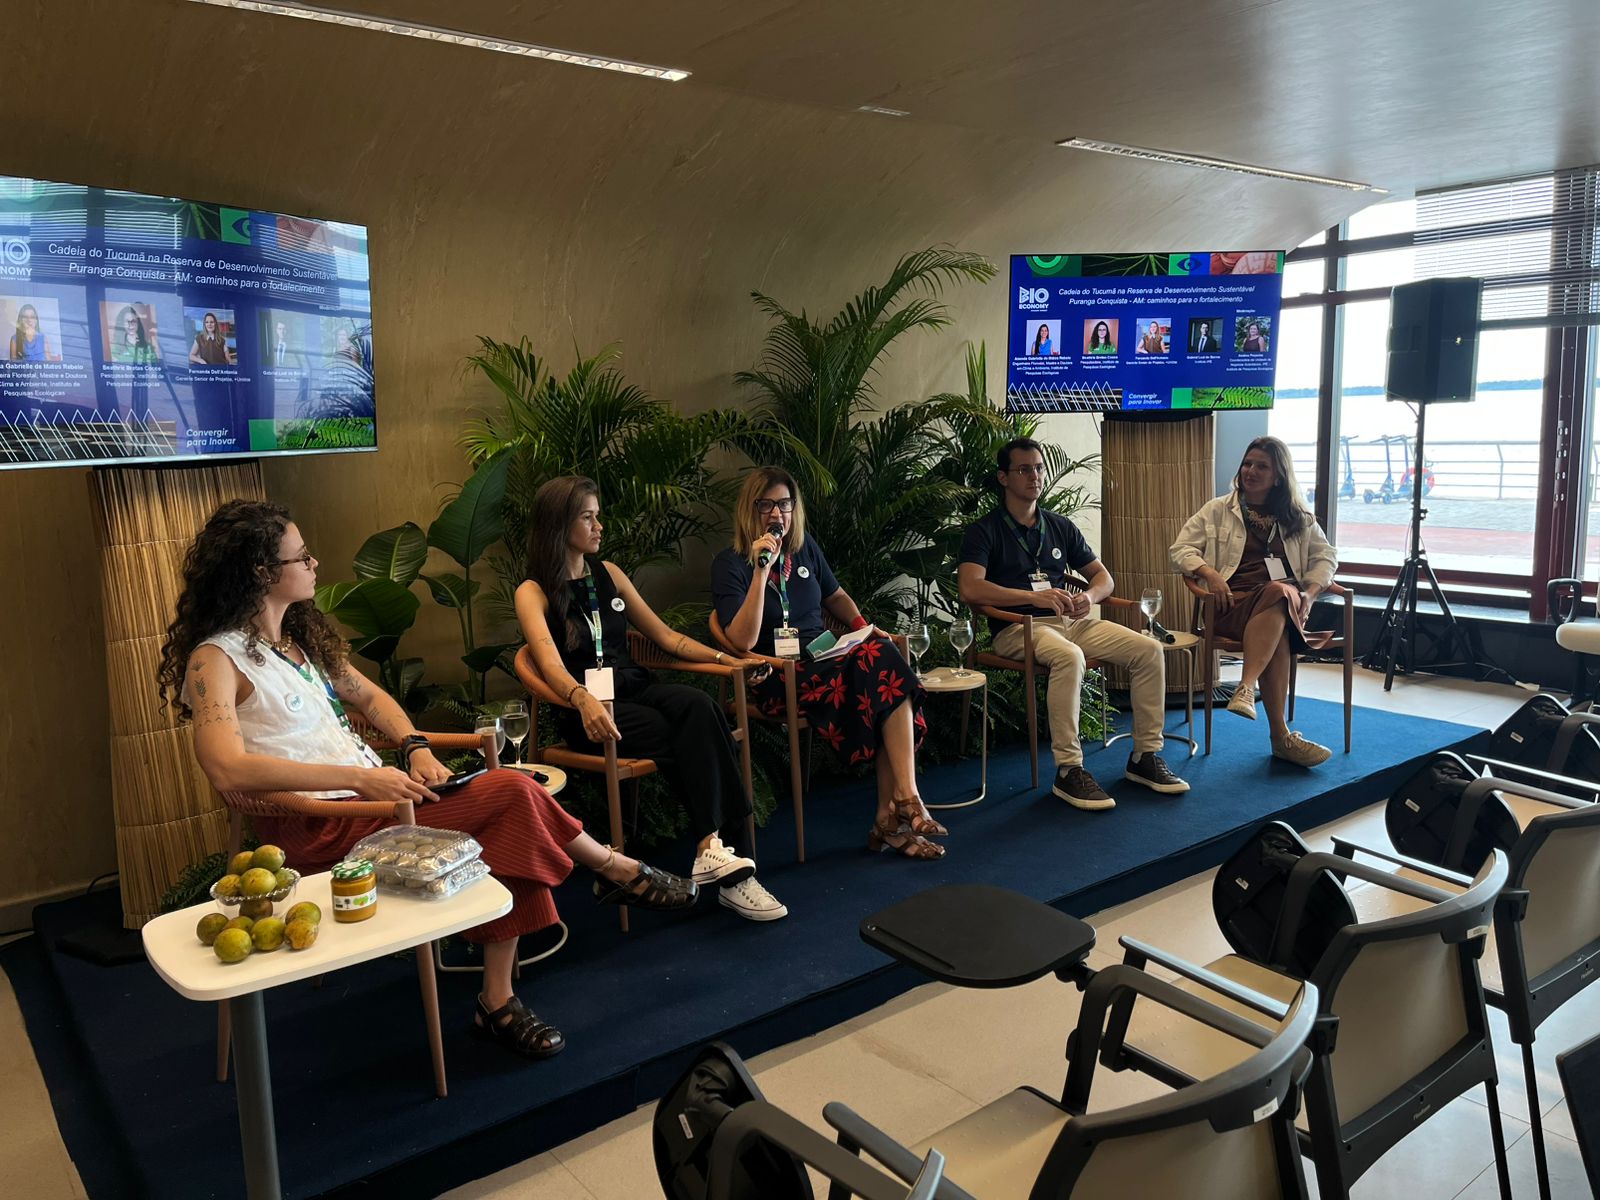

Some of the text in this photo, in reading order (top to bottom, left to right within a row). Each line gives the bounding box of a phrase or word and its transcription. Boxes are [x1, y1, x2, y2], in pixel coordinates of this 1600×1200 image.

[48, 243, 86, 256] Cadeia
[89, 247, 103, 258] do
[106, 248, 145, 261] Tucumã
[147, 254, 160, 263] na
[163, 254, 202, 268] Reserva
[204, 258, 216, 269] de
[218, 259, 291, 277] Desenvolvimento
[68, 263, 113, 277] Puranga
[116, 266, 166, 280] Conquista
[174, 272, 193, 283] AM:
[195, 274, 239, 287] caminhos
[240, 279, 260, 289] para
[261, 281, 268, 289] o
[269, 281, 325, 295] fortalecimento
[1019, 286, 1050, 304] BIO
[1092, 287, 1117, 295] Tucumã
[1163, 286, 1217, 294] Desenvolvimento
[1218, 285, 1256, 293] Sustentável
[1068, 298, 1096, 306] Puranga
[1096, 297, 1128, 306] Conquista
[1147, 296, 1178, 304] caminhos
[1177, 297, 1192, 305] para
[186, 428, 229, 438] Convergir
[186, 437, 236, 448] para Inovar
